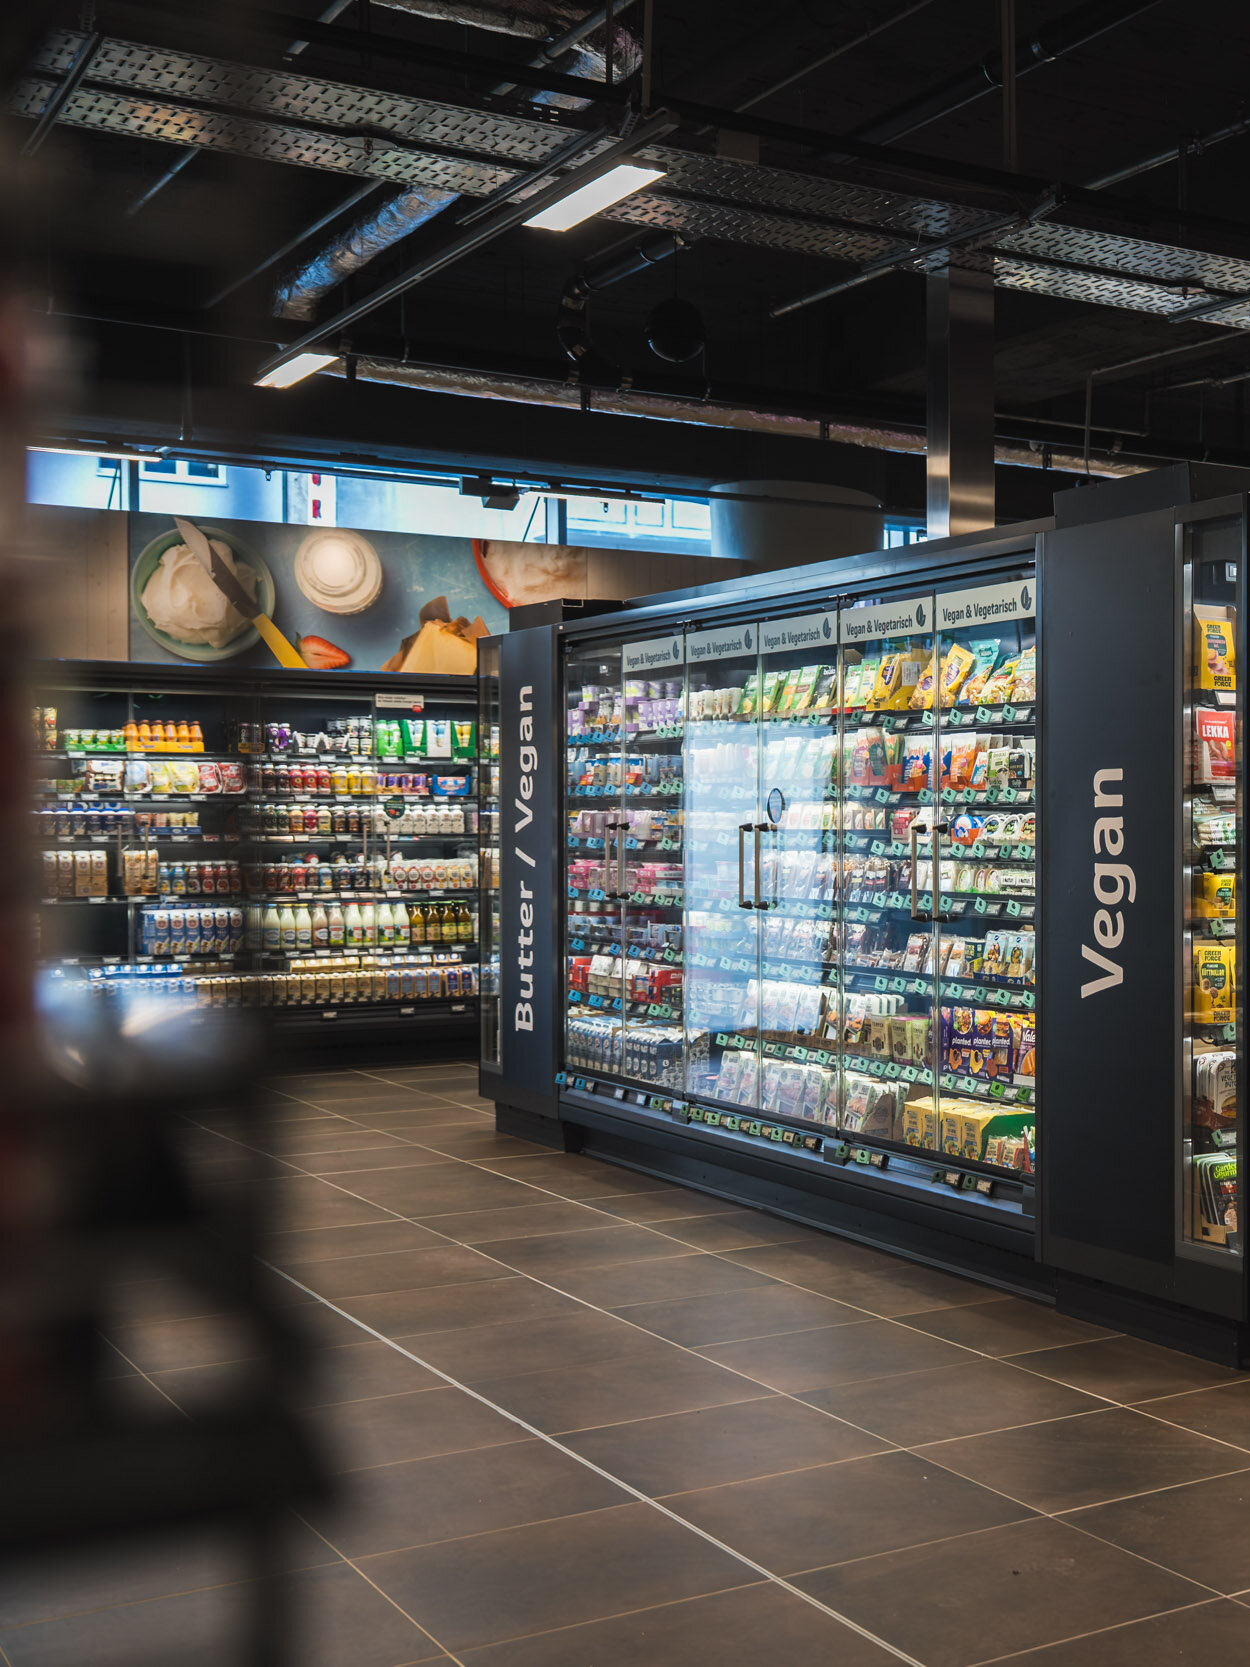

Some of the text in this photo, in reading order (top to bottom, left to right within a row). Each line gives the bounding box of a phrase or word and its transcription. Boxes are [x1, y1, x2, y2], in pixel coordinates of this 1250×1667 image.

[943, 598, 1017, 624] Vegan & Vegetarisch
[846, 614, 913, 638] Vegan & Vegetarisch
[691, 639, 742, 658] Vegan & Vegetarisch
[764, 628, 820, 649] Vegan & Vegetarisch
[626, 650, 670, 668] Vegan & Vegetarisch
[1202, 725, 1229, 738] LEKKA
[515, 685, 538, 1032] Butter / Vegan
[1081, 768, 1136, 999] Vegan
[1023, 1030, 1035, 1043] Vale
